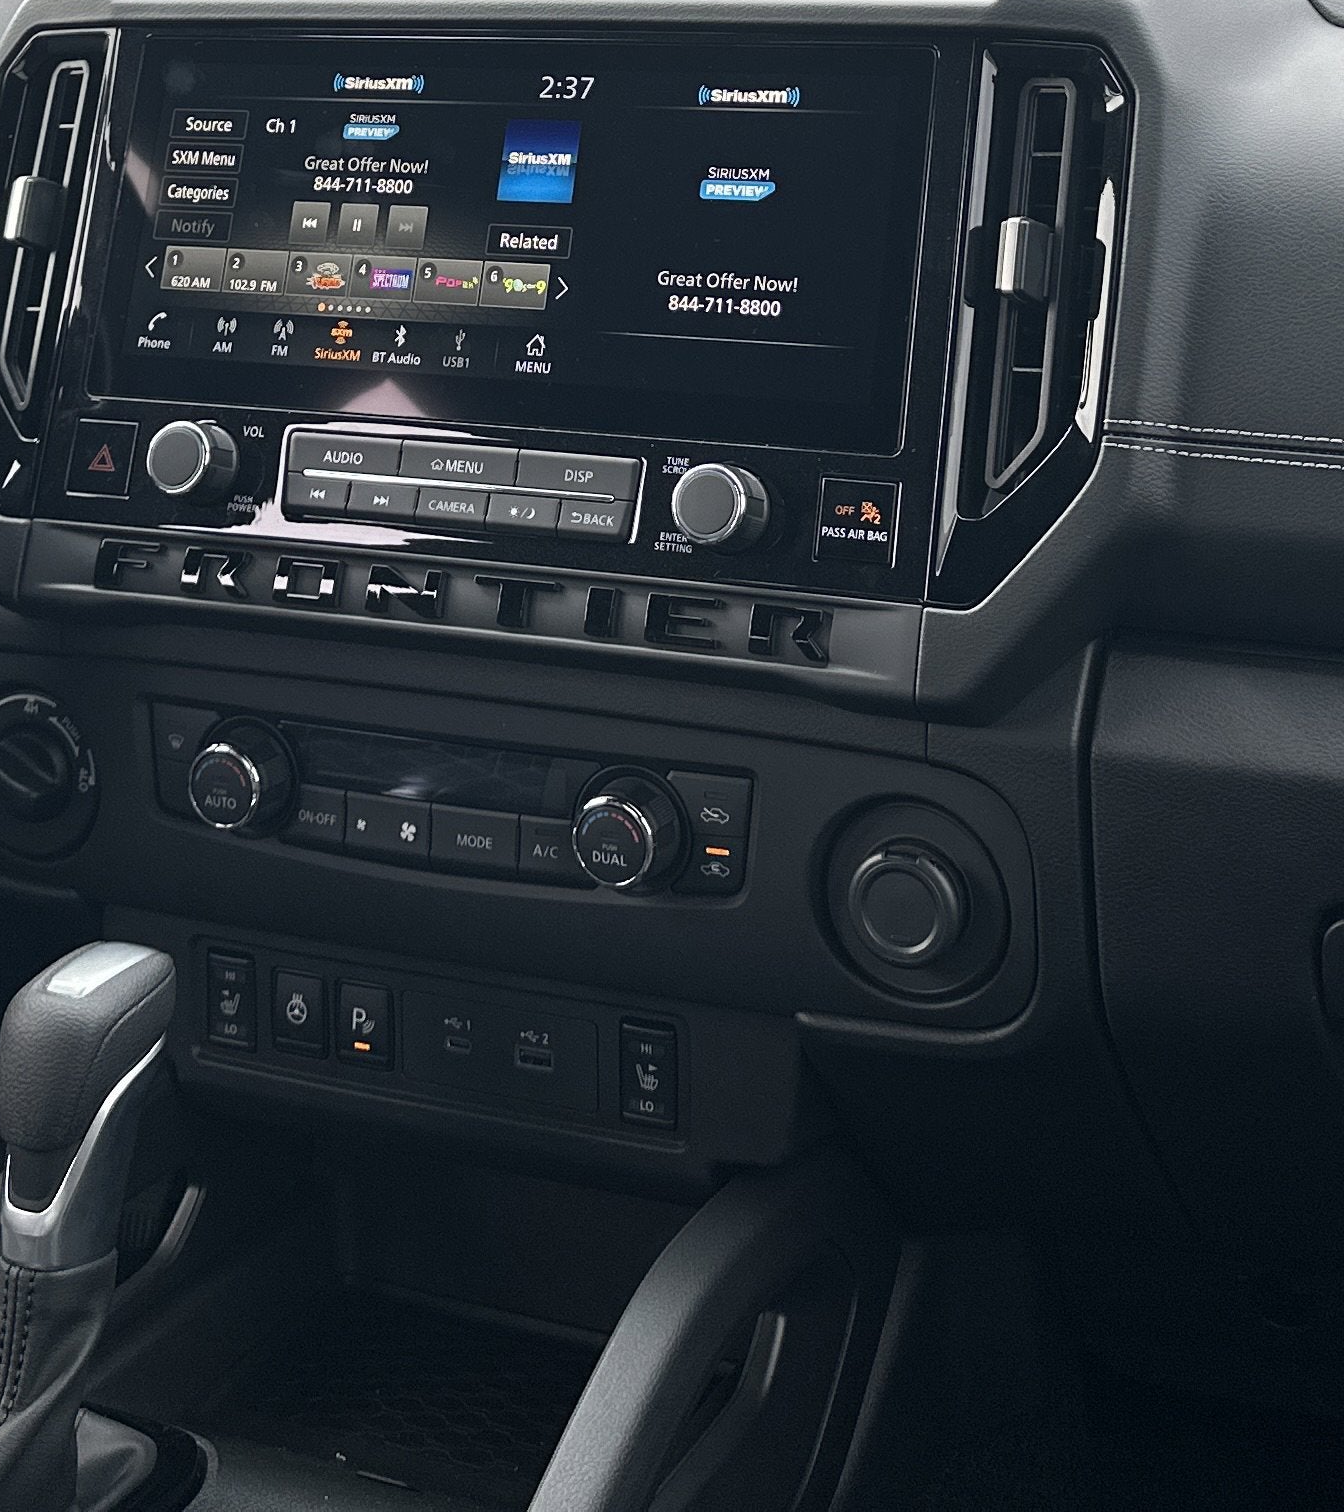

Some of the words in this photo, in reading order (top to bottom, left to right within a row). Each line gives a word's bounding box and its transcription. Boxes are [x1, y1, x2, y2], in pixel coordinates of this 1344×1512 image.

[539, 76, 595, 99] 2:37
[186, 117, 233, 132] Source
[265, 118, 285, 134] Ch
[289, 119, 296, 133] 1
[172, 150, 198, 165] SXM
[201, 151, 235, 166] Menu
[304, 155, 345, 170] Great
[348, 157, 387, 172] Offer
[389, 159, 429, 174] Now!
[508, 151, 572, 166] SiriusXM
[708, 167, 770, 180] SIRIUSXM
[313, 176, 414, 194] 844-711-8800
[167, 184, 229, 203] Categories
[172, 219, 215, 237] Notify
[499, 233, 558, 250] Related
[172, 255, 179, 266] 1
[232, 258, 240, 269] 2
[294, 261, 303, 272] 3
[358, 264, 367, 275] 4
[424, 267, 432, 279] 5
[490, 271, 498, 282] 6
[170, 276, 190, 288] 620
[192, 277, 210, 289] AM
[229, 279, 256, 291] 102.9
[260, 281, 277, 292] FM
[657, 270, 702, 288] Great
[706, 273, 750, 290] Offer
[753, 275, 798, 292] Now!
[668, 295, 781, 316] 844-711-8800
[137, 336, 170, 349] Phone
[212, 341, 233, 353] AM
[271, 345, 288, 357] FM
[314, 347, 361, 362] SiriusXM
[372, 351, 385, 363] BT
[387, 352, 421, 365] Audio
[442, 355, 470, 368] USB1
[515, 360, 551, 374] MENU
[243, 425, 265, 439] VOL
[323, 450, 363, 465] AUDIO
[667, 456, 690, 467] TUNE
[445, 460, 484, 475] MENU
[564, 469, 594, 483] DISP
[428, 499, 475, 514] CAMERA
[834, 504, 855, 516] OFF
[582, 513, 615, 527] BACK
[821, 526, 846, 538] PASS
[847, 528, 865, 540] AIR
[867, 530, 888, 542] BAG
[654, 542, 693, 554] SETTING
[94, 538, 833, 669] FRONTIER
[205, 794, 237, 810] AUTO
[457, 833, 493, 850] MODE
[532, 844, 559, 859] A/C
[592, 850, 628, 868] DUAL
[638, 1100, 655, 1113] LO
